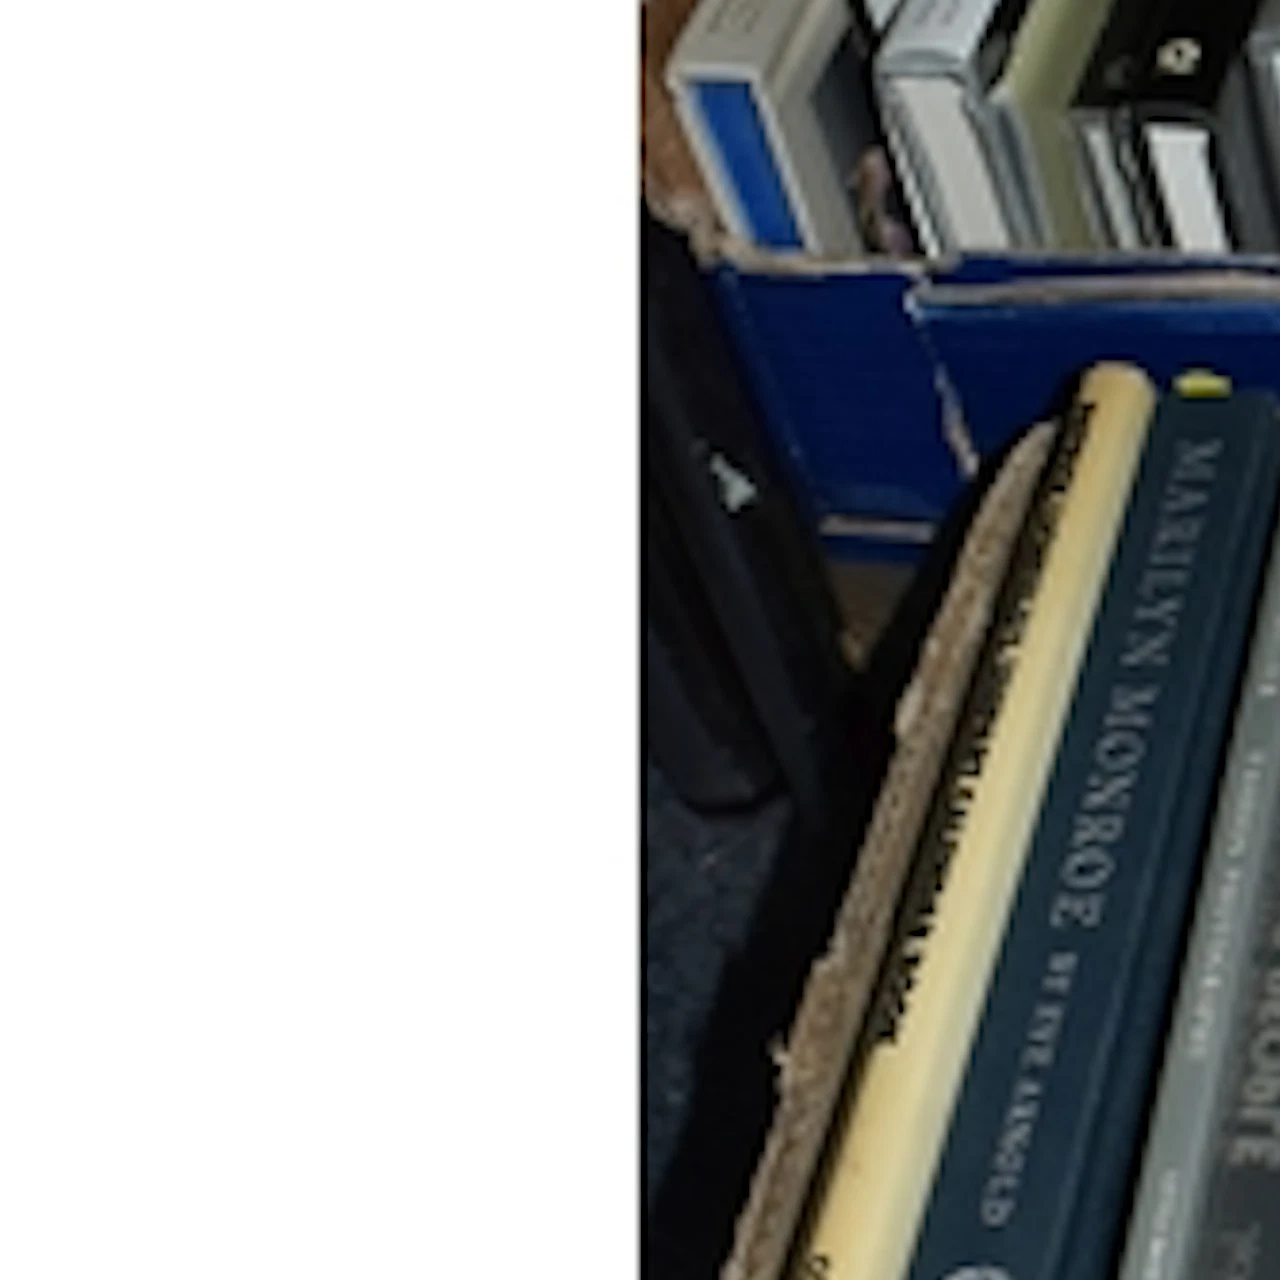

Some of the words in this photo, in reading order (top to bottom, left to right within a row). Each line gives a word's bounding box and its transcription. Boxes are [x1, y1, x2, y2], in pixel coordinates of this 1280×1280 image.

[1121, 436, 1226, 669] MARILYN
[1050, 682, 1162, 932] MONROE
[982, 1078, 1044, 1227] ARNOLD
